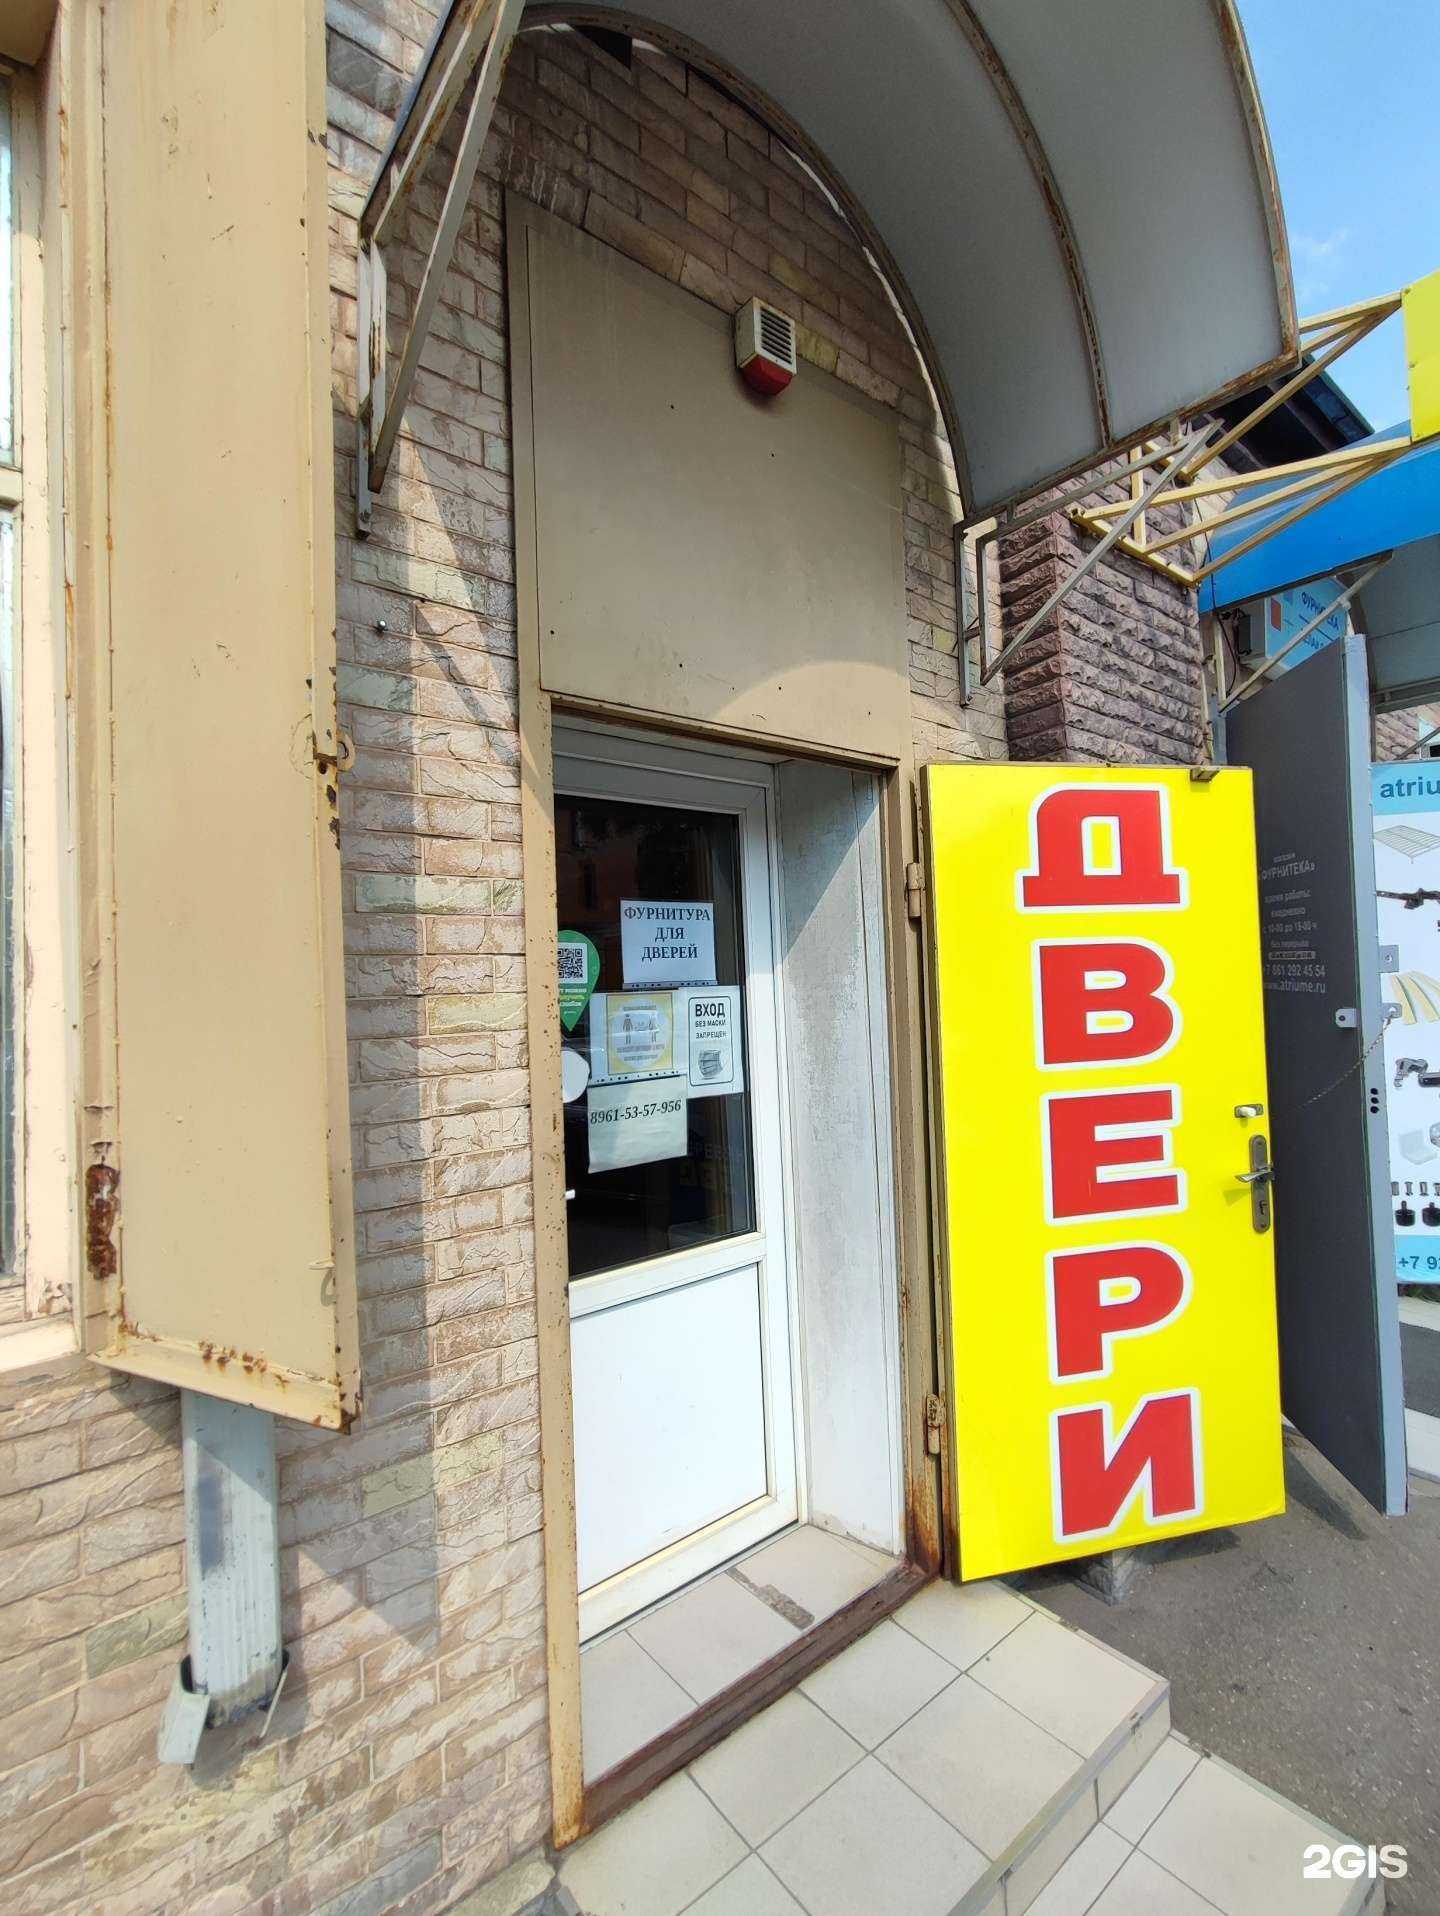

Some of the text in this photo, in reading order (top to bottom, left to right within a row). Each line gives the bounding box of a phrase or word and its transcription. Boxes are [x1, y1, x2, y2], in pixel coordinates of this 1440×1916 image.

[623, 906, 711, 921] ФУРНИТУРА
[654, 926, 686, 942] ДЛЯ
[641, 943, 699, 962] ДВЕРЕЙ
[695, 1002, 726, 1018] ВХОД
[707, 1019, 726, 1027] МАСКИ
[589, 1100, 682, 1125] 8961-53-57-956
[1019, 785, 1200, 1540] ДВЕРИ
[1399, 1255, 1420, 1270] +7
